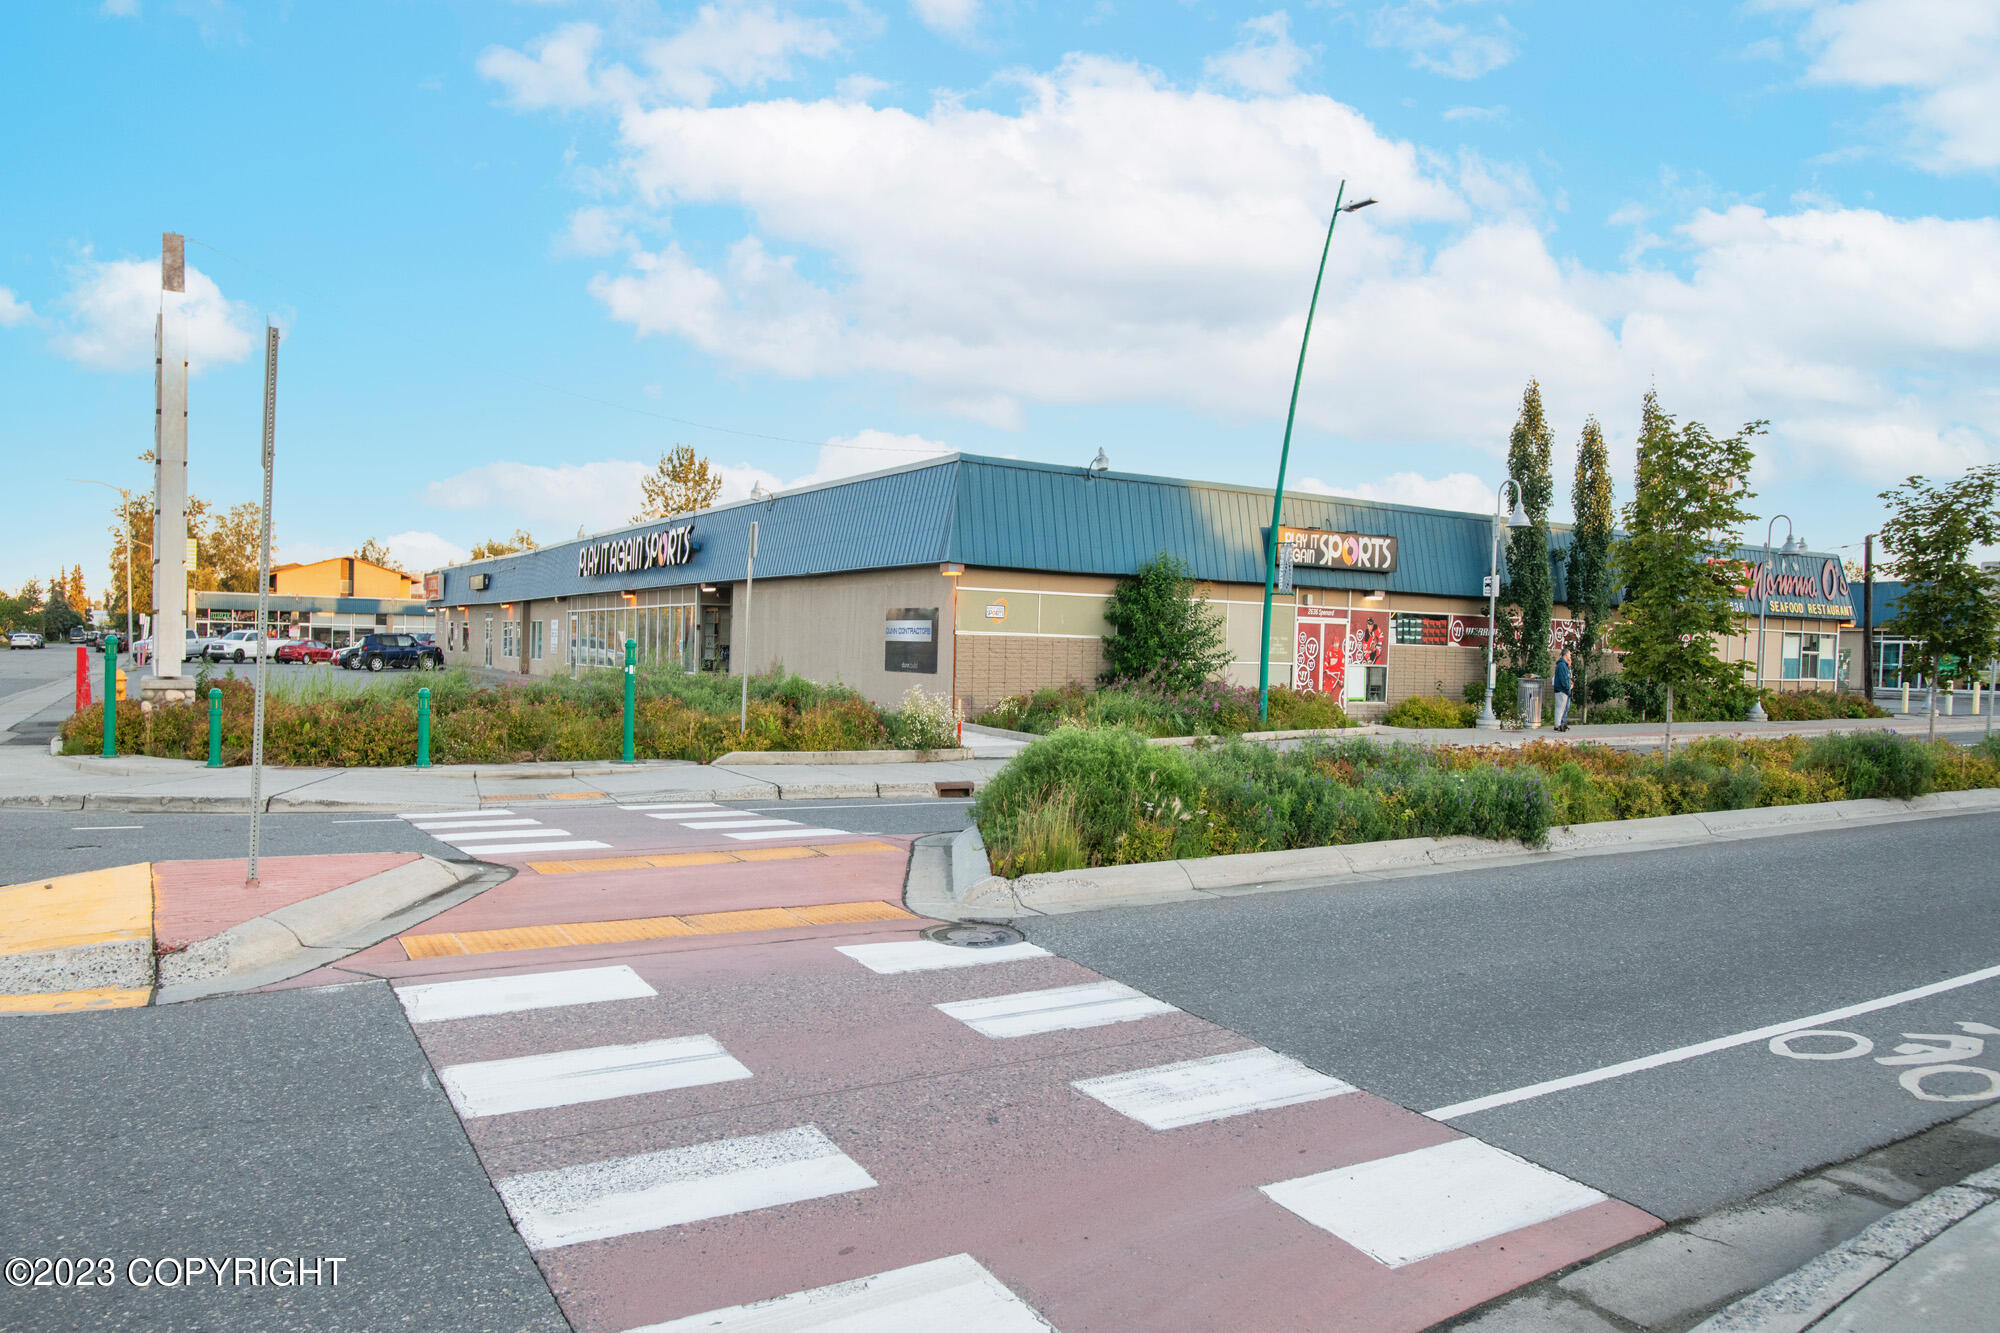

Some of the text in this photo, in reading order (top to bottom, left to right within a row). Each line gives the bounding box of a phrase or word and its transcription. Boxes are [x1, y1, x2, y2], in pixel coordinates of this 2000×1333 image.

[1284, 532, 1320, 549] PLAY IT
[578, 524, 692, 577] PLAY IT AGAIN SPORTS
[1290, 548, 1315, 564] GAIN
[1319, 534, 1391, 568] SPORTS
[1769, 600, 1853, 617] SEAFOOD RESTAURANT
